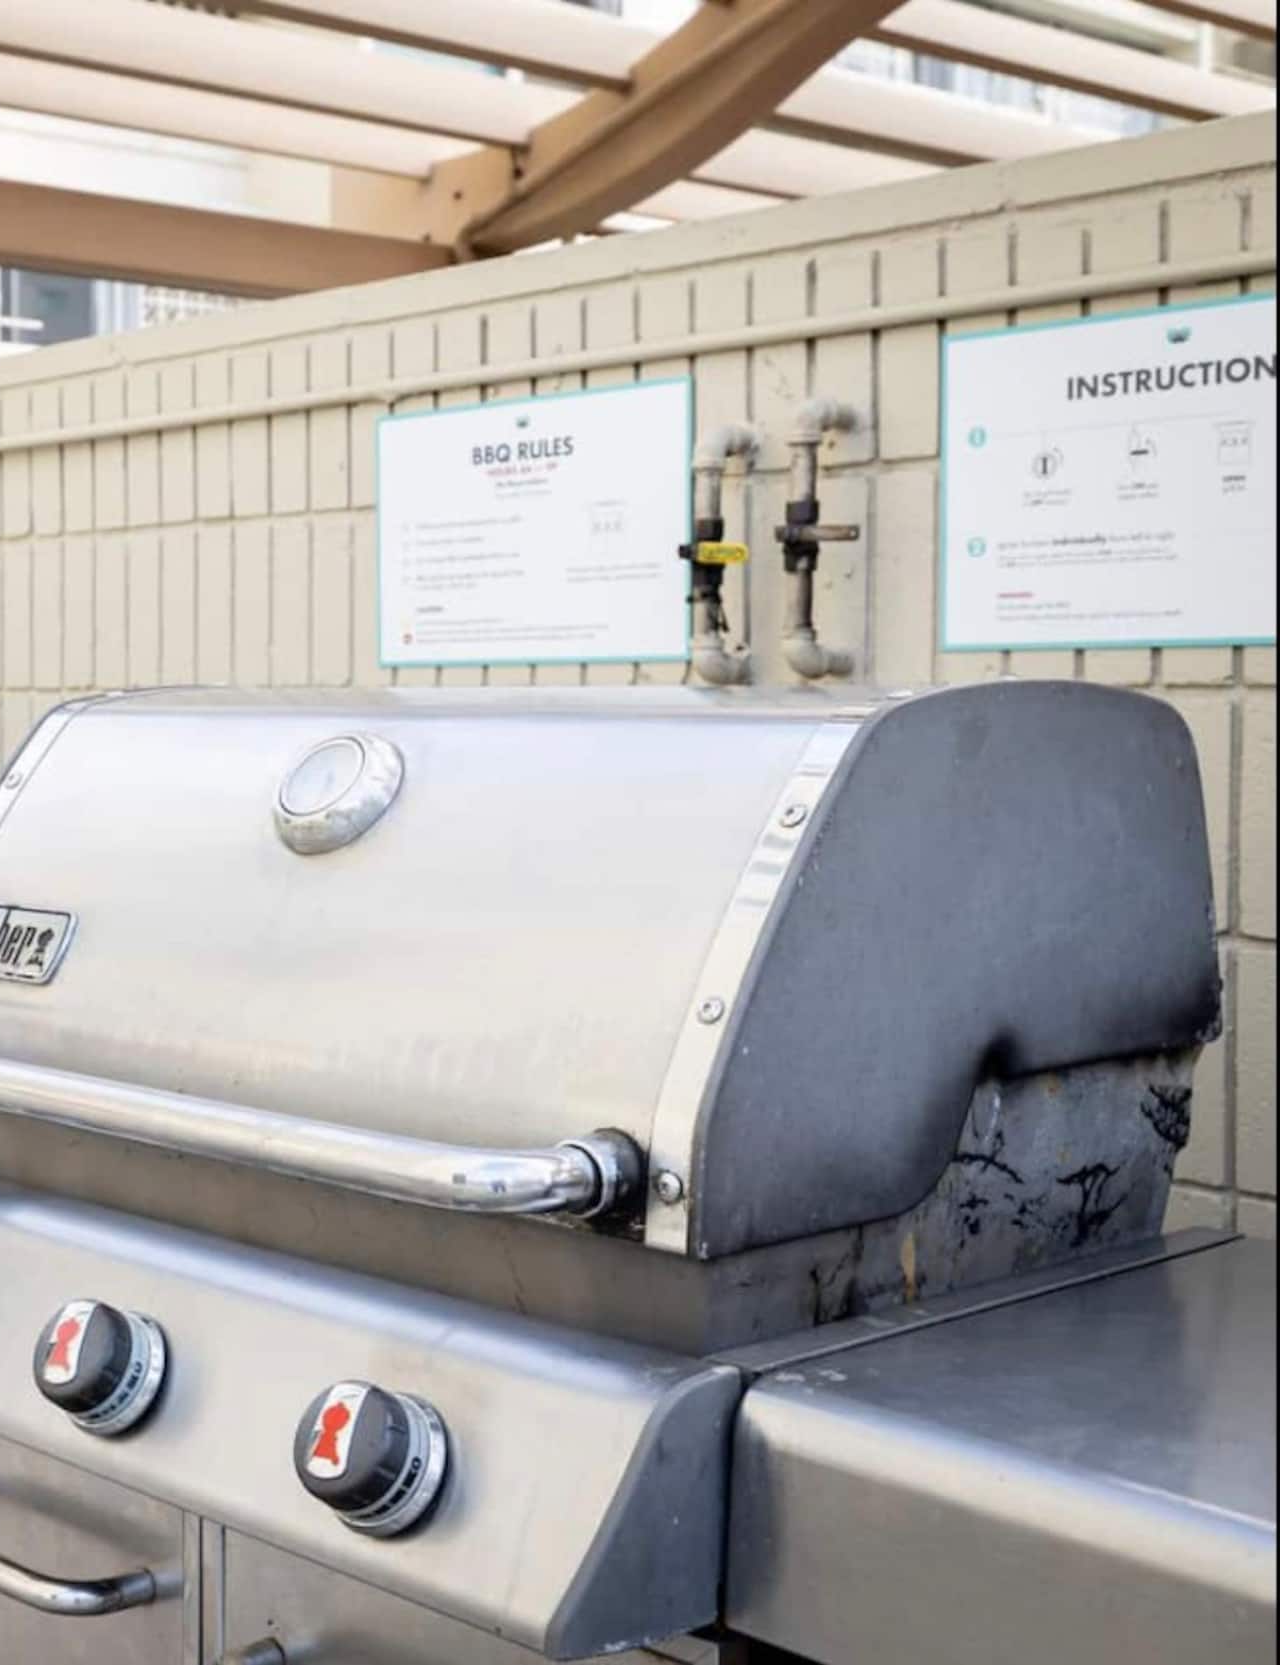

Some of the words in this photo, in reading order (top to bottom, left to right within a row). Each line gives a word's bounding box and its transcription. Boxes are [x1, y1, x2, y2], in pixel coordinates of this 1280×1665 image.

[1066, 353, 1277, 401] INSTRUCTION
[471, 442, 511, 466] BBQ
[517, 435, 574, 460] RULES
